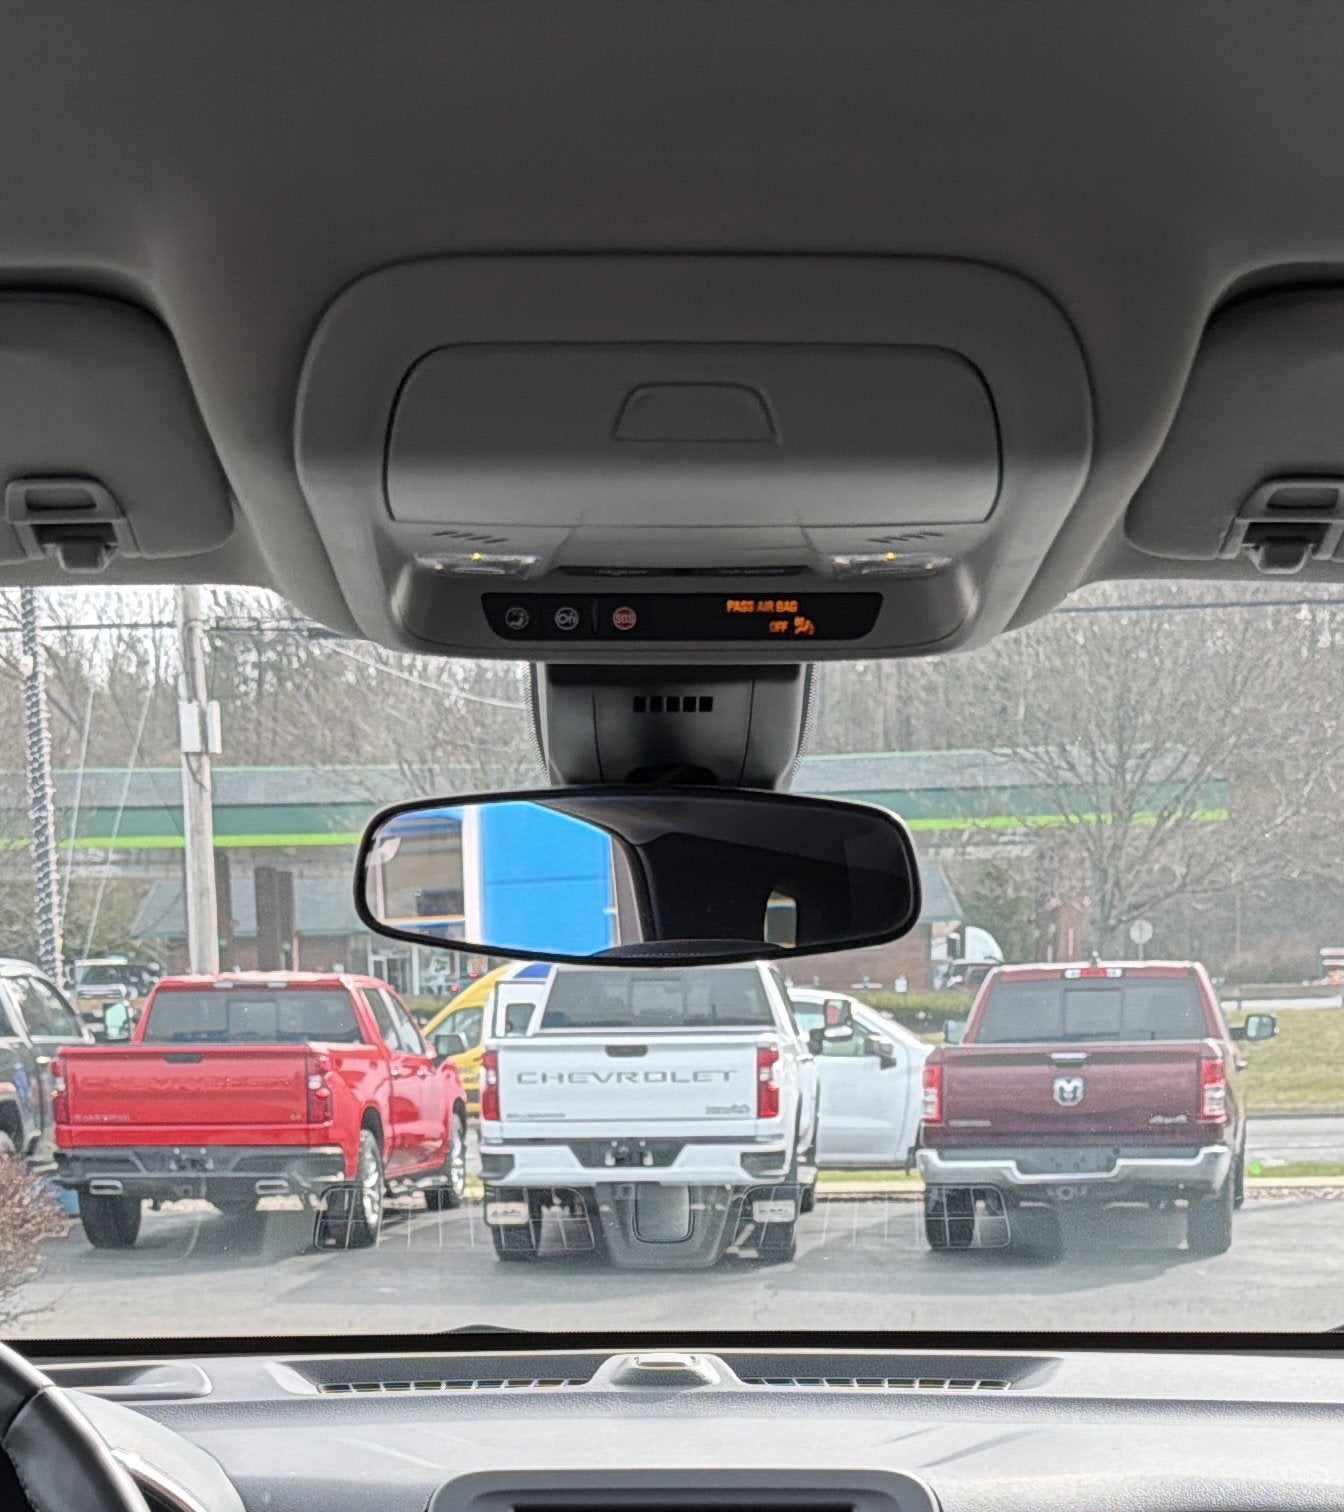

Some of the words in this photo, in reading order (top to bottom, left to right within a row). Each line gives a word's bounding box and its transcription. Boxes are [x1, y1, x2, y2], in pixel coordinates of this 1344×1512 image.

[726, 599, 755, 613] PASS
[757, 600, 775, 613] AIR
[776, 600, 799, 613] BAG
[769, 620, 789, 633] OFF
[516, 1069, 739, 1085] CHEVROLET
